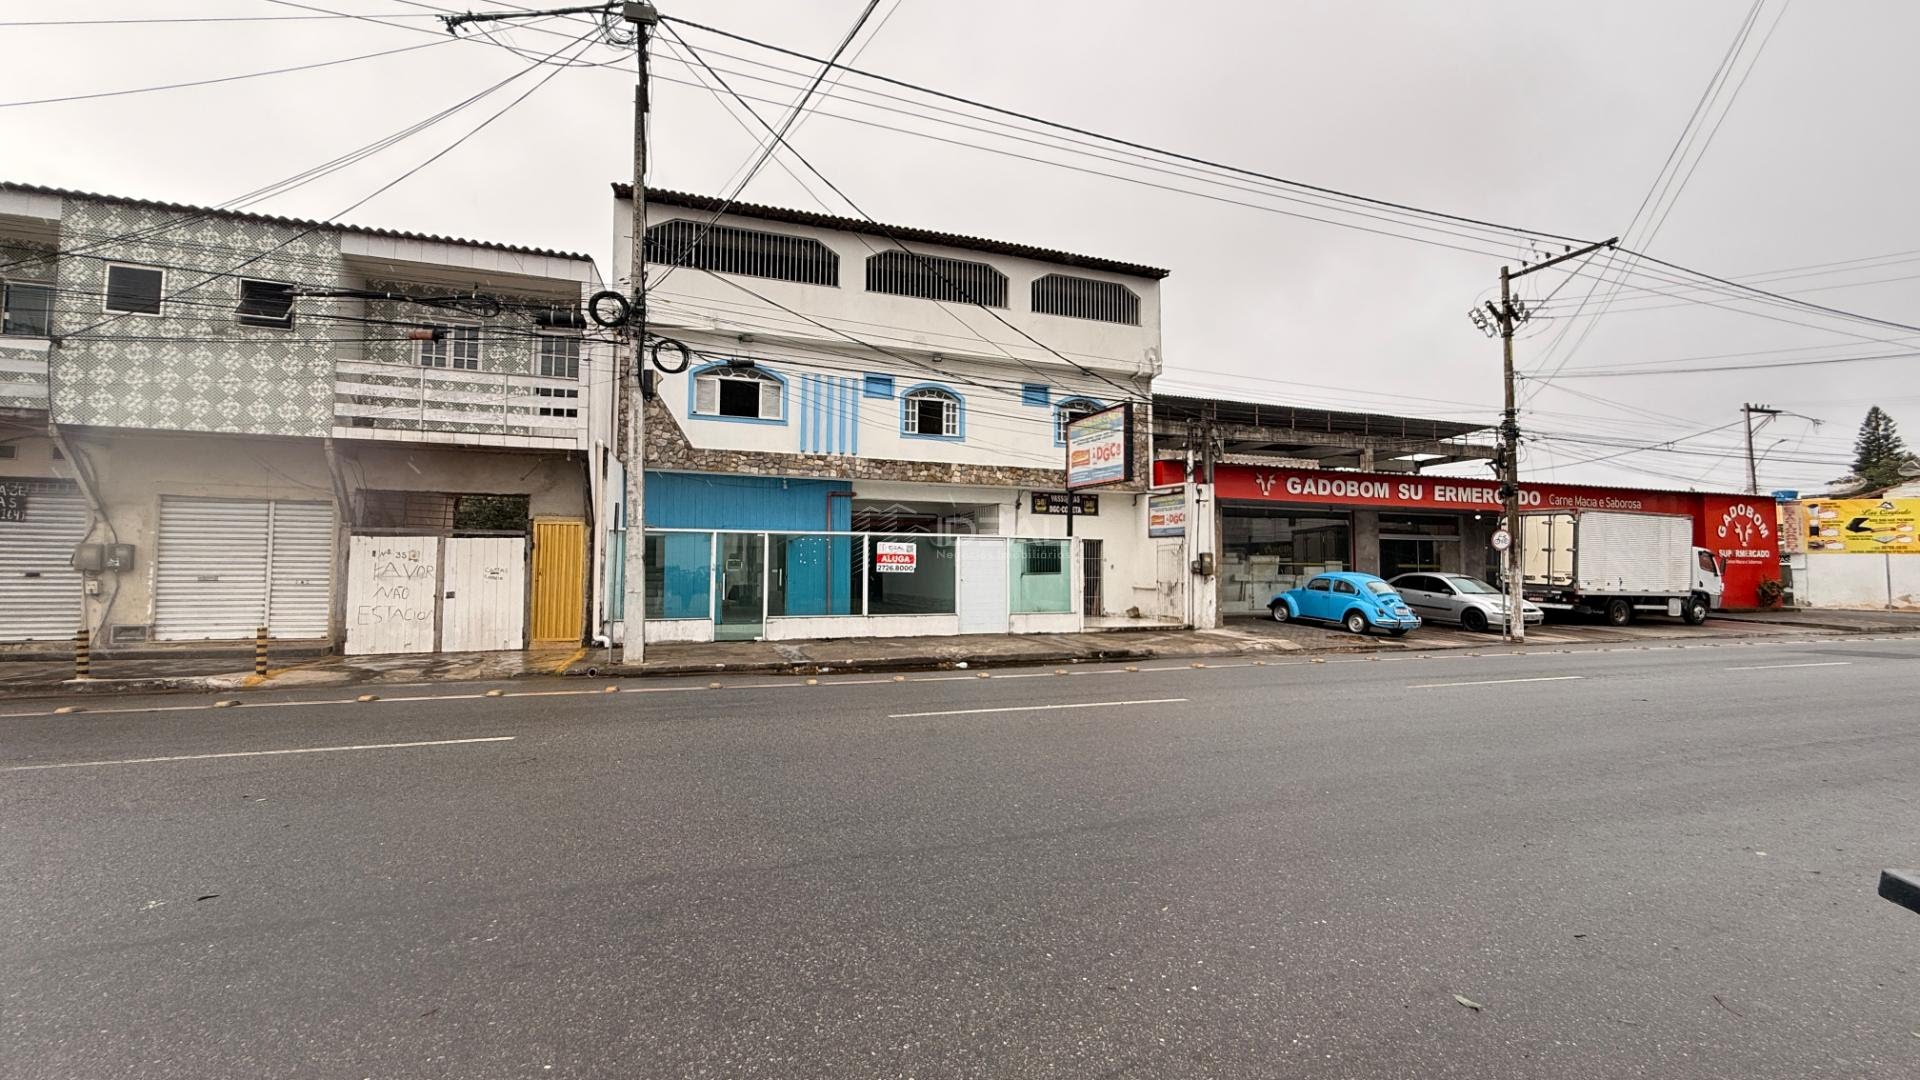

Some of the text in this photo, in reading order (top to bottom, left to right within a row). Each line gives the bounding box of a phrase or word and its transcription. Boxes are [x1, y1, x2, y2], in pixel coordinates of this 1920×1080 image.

[1286, 477, 1390, 499] GADOBOM
[1548, 494, 1573, 506] Carne
[1599, 499, 1605, 508] e
[1606, 497, 1642, 510] Saborosa
[1717, 503, 1770, 538] GADOBOM
[880, 554, 912, 563] ALUGA
[1718, 549, 1770, 558] SUPRMERCADO
